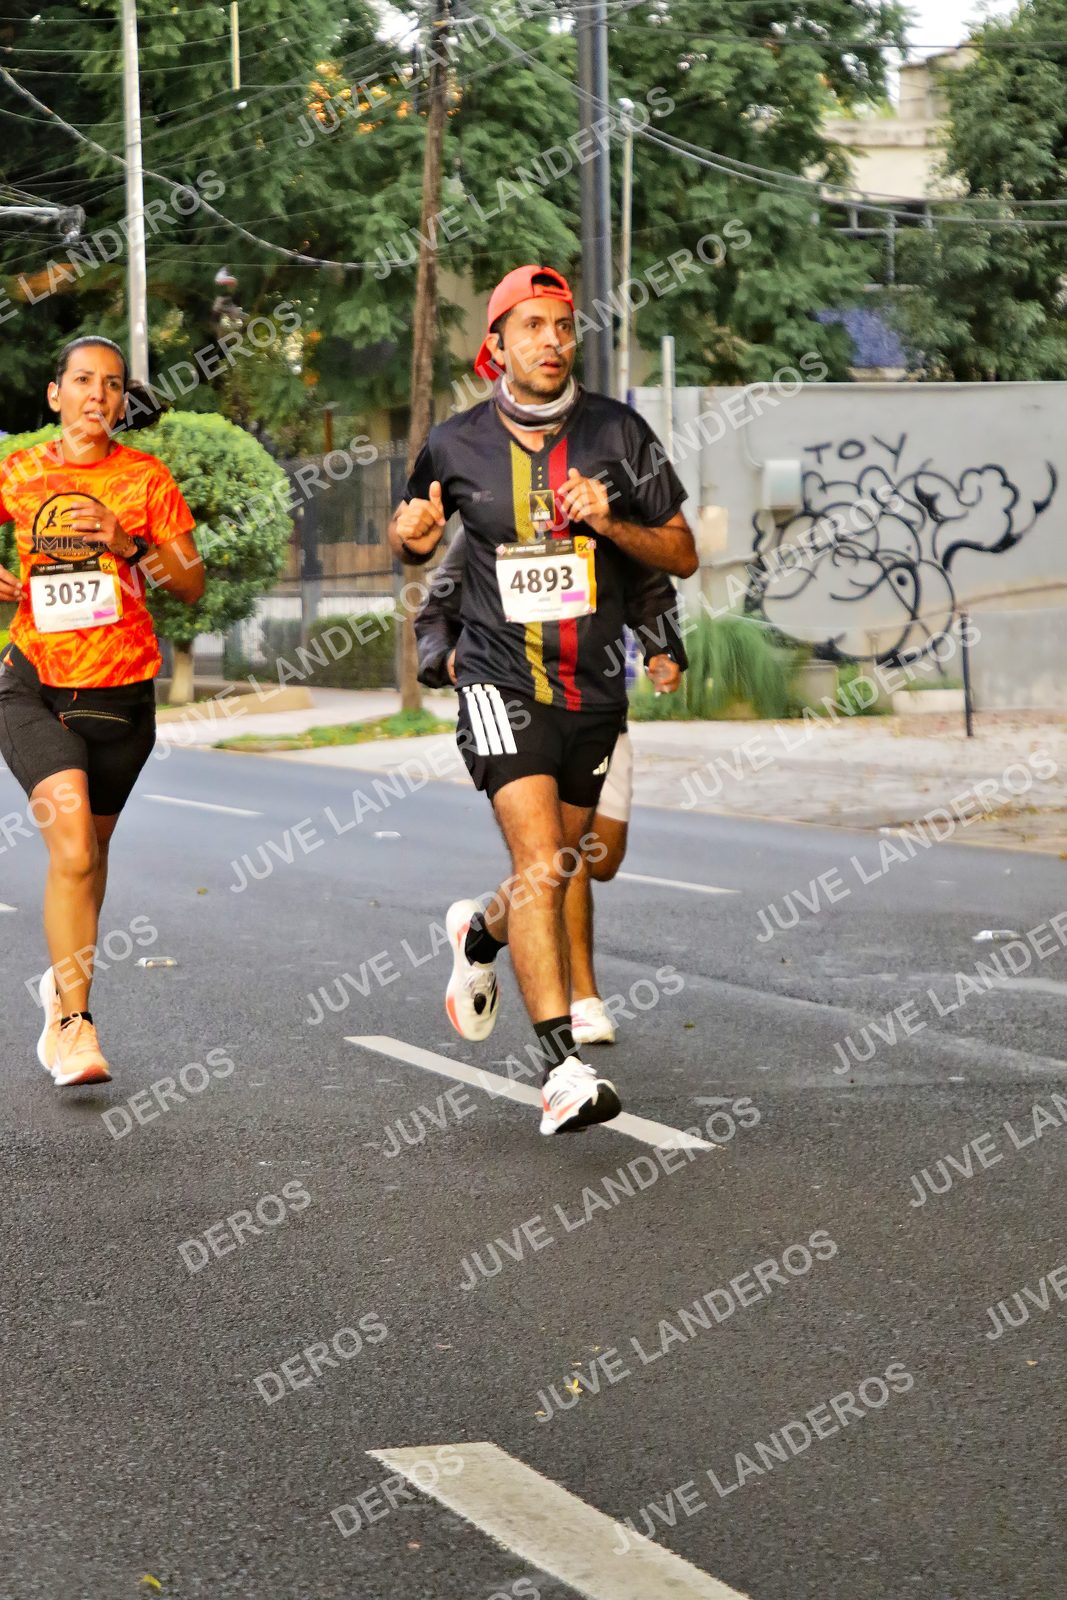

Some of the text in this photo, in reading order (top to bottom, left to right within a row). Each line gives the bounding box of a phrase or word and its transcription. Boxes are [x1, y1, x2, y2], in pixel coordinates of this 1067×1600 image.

[804, 433, 906, 472] TOY
[44, 579, 101, 606] 3037
[510, 565, 574, 594] 4893
